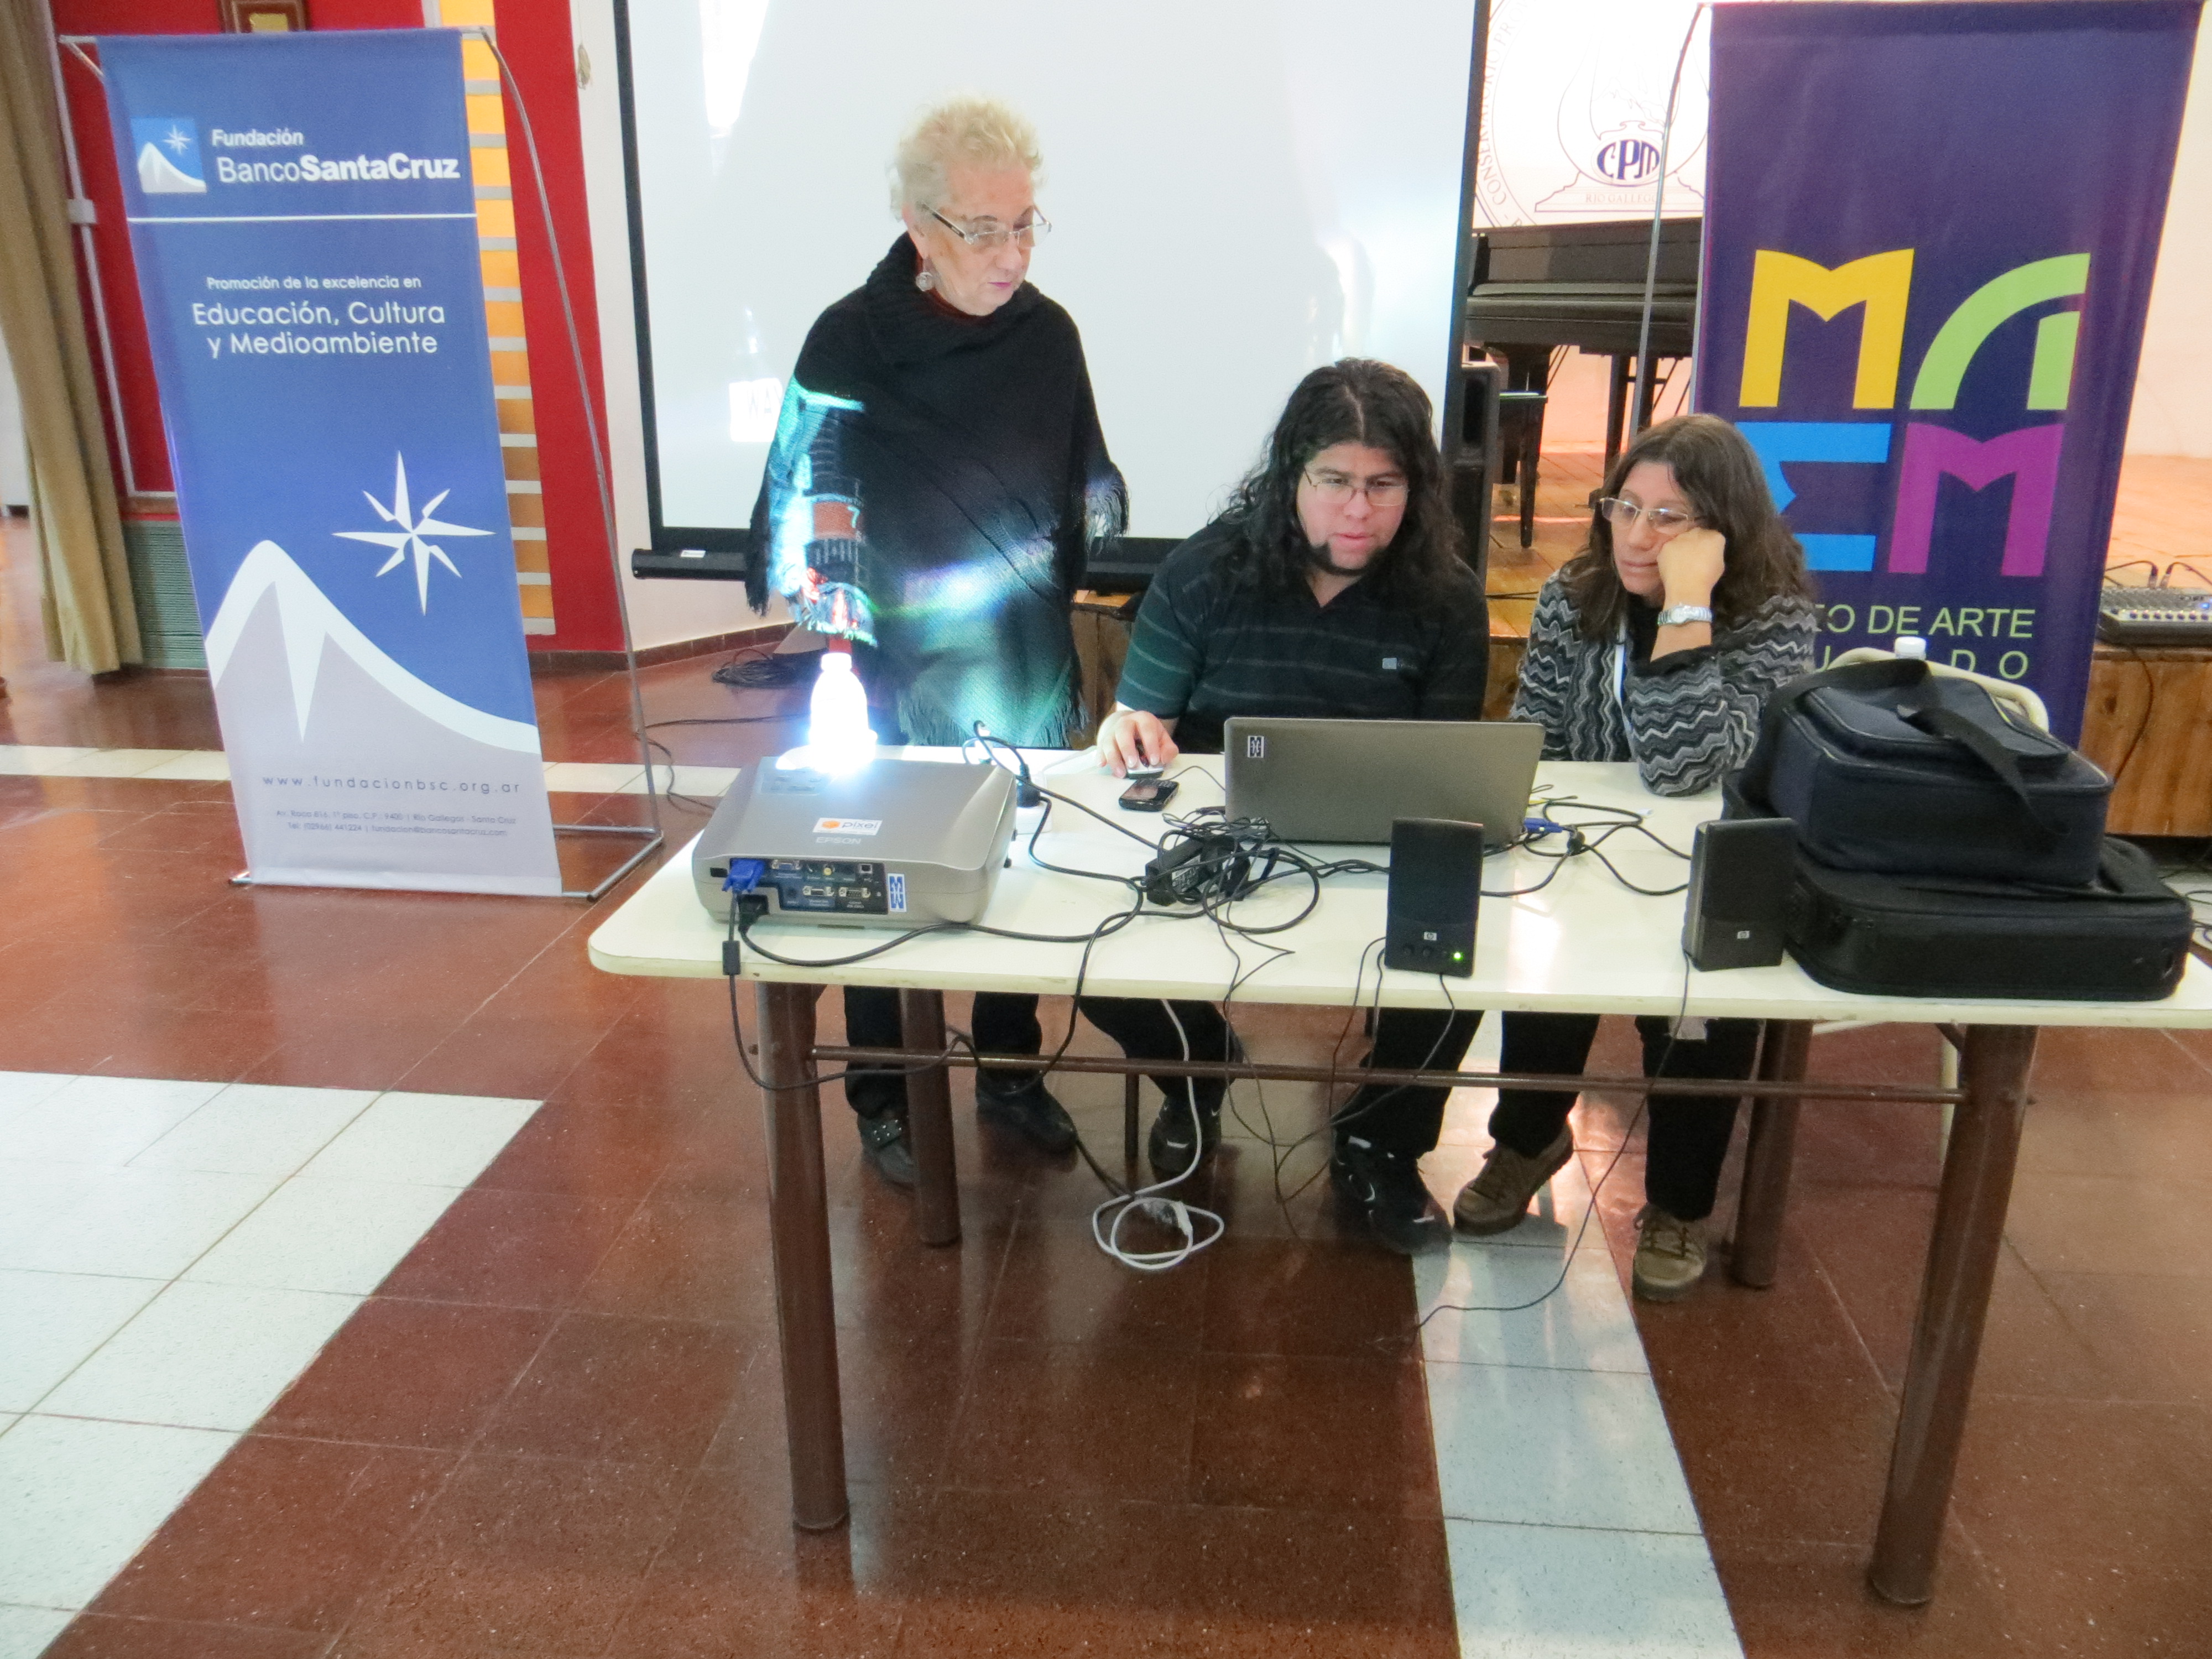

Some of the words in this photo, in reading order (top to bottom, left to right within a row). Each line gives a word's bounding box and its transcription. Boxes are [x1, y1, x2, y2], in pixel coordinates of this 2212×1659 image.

[211, 128, 304, 147] Fundación
[216, 152, 461, 184] BancoSantaCruz
[1597, 139, 1660, 180] CPM
[206, 276, 279, 290] Promoción
[284, 276, 302, 290] de
[305, 276, 319, 289] la
[322, 275, 399, 289] excelencia
[403, 277, 421, 288] en
[192, 301, 340, 327] Educación,
[348, 301, 445, 324] Cultura
[207, 336, 221, 358] y
[230, 331, 438, 354] Medioambiente
[1867, 606, 1921, 635] DE
[1928, 608, 2036, 638] ARTE
[263, 775, 520, 794] www.fundacionbsc.org.ar
